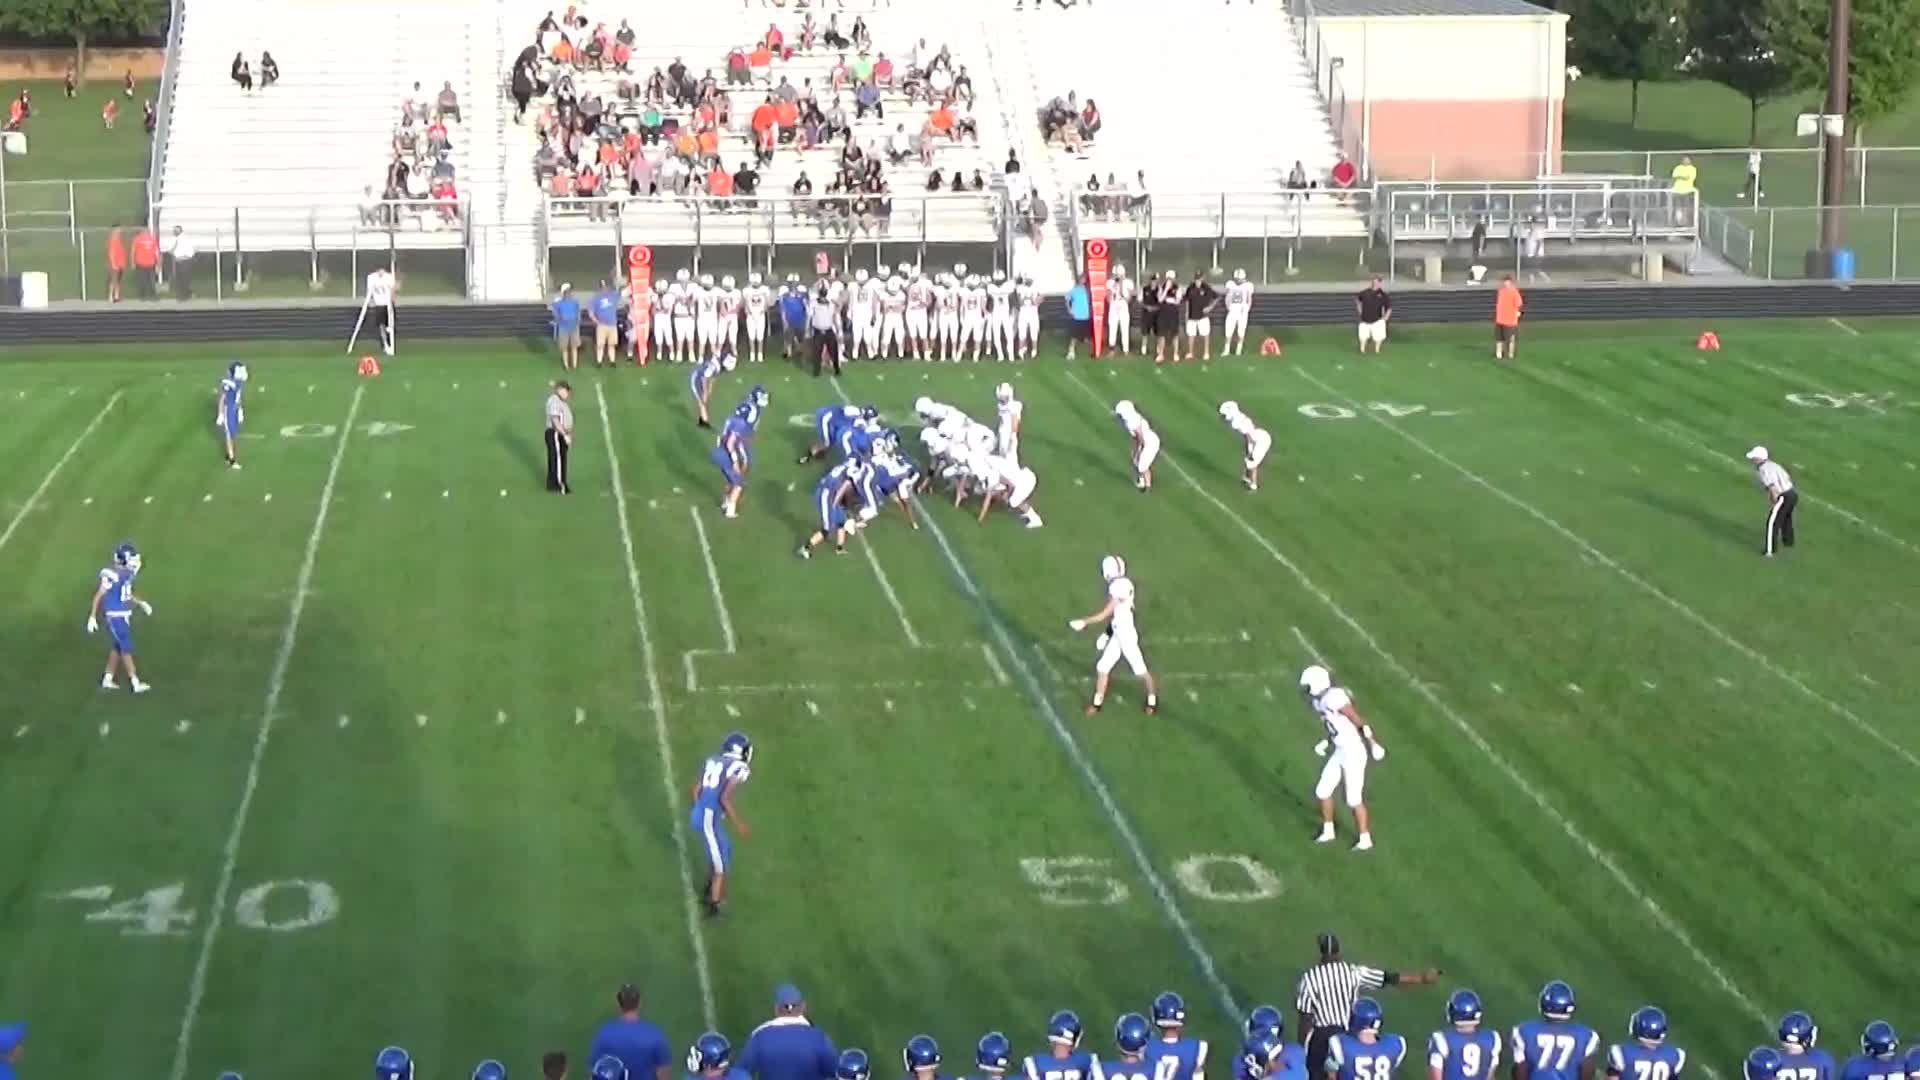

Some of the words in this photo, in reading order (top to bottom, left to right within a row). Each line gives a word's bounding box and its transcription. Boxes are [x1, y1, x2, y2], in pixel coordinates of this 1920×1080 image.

[1018, 852, 1284, 904] 50
[85, 880, 341, 936] 40
[1354, 1055, 1391, 1080] 58
[1462, 1043, 1481, 1077] 9
[1536, 1033, 1576, 1071] 77
